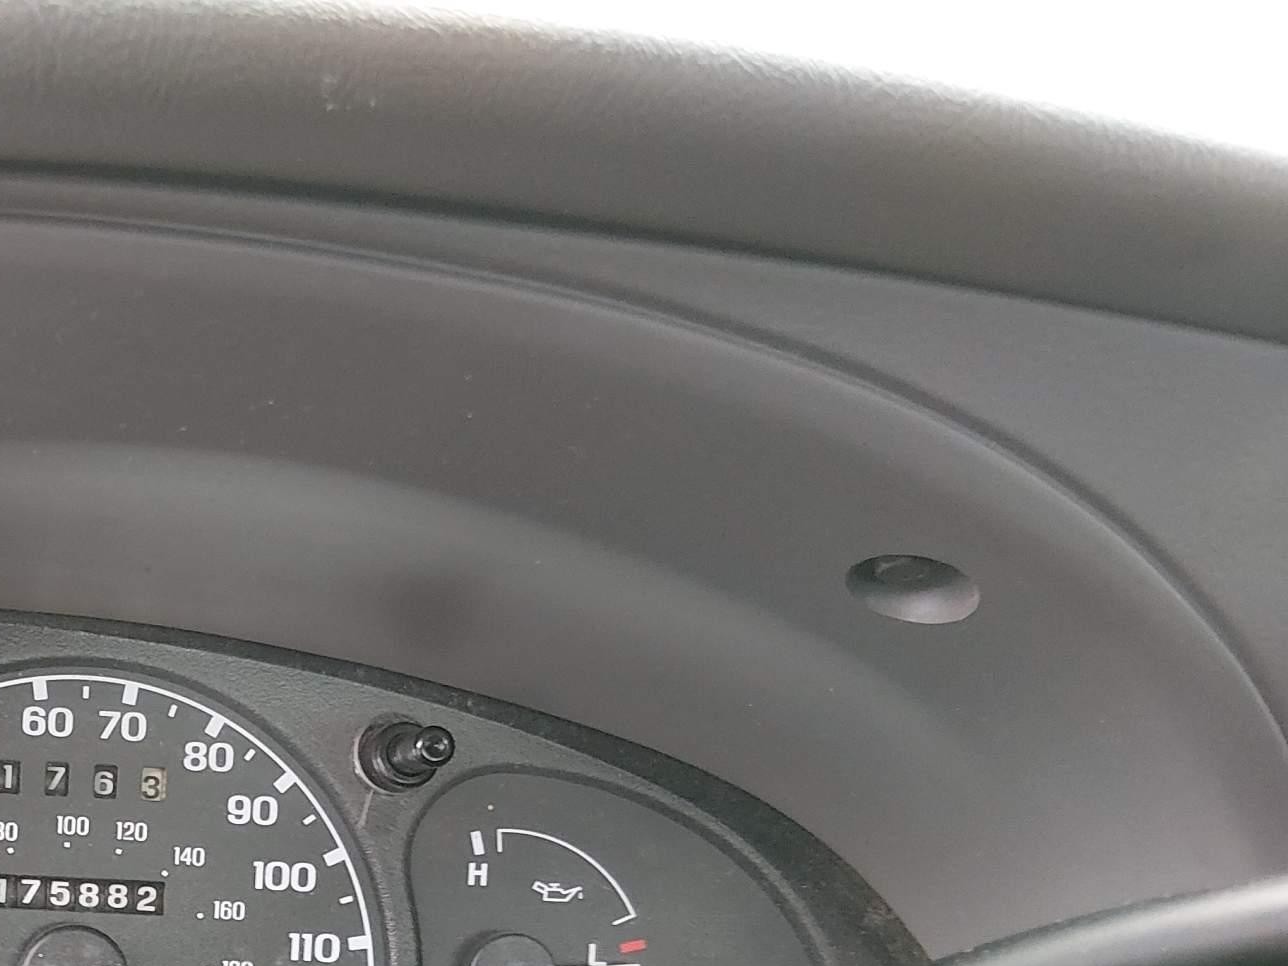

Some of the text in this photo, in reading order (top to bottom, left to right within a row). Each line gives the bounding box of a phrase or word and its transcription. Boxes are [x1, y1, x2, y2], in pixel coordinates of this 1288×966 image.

[22, 706, 74, 738] 60
[98, 710, 147, 742] 70
[183, 741, 235, 773] 80
[227, 794, 279, 826] 90
[56, 815, 90, 836] 100
[116, 821, 148, 842] 120
[173, 846, 206, 867] 140
[253, 861, 317, 892] 100
[467, 862, 488, 887] H
[213, 900, 246, 921] 160
[288, 932, 341, 963] 110
[588, 943, 607, 966] L
